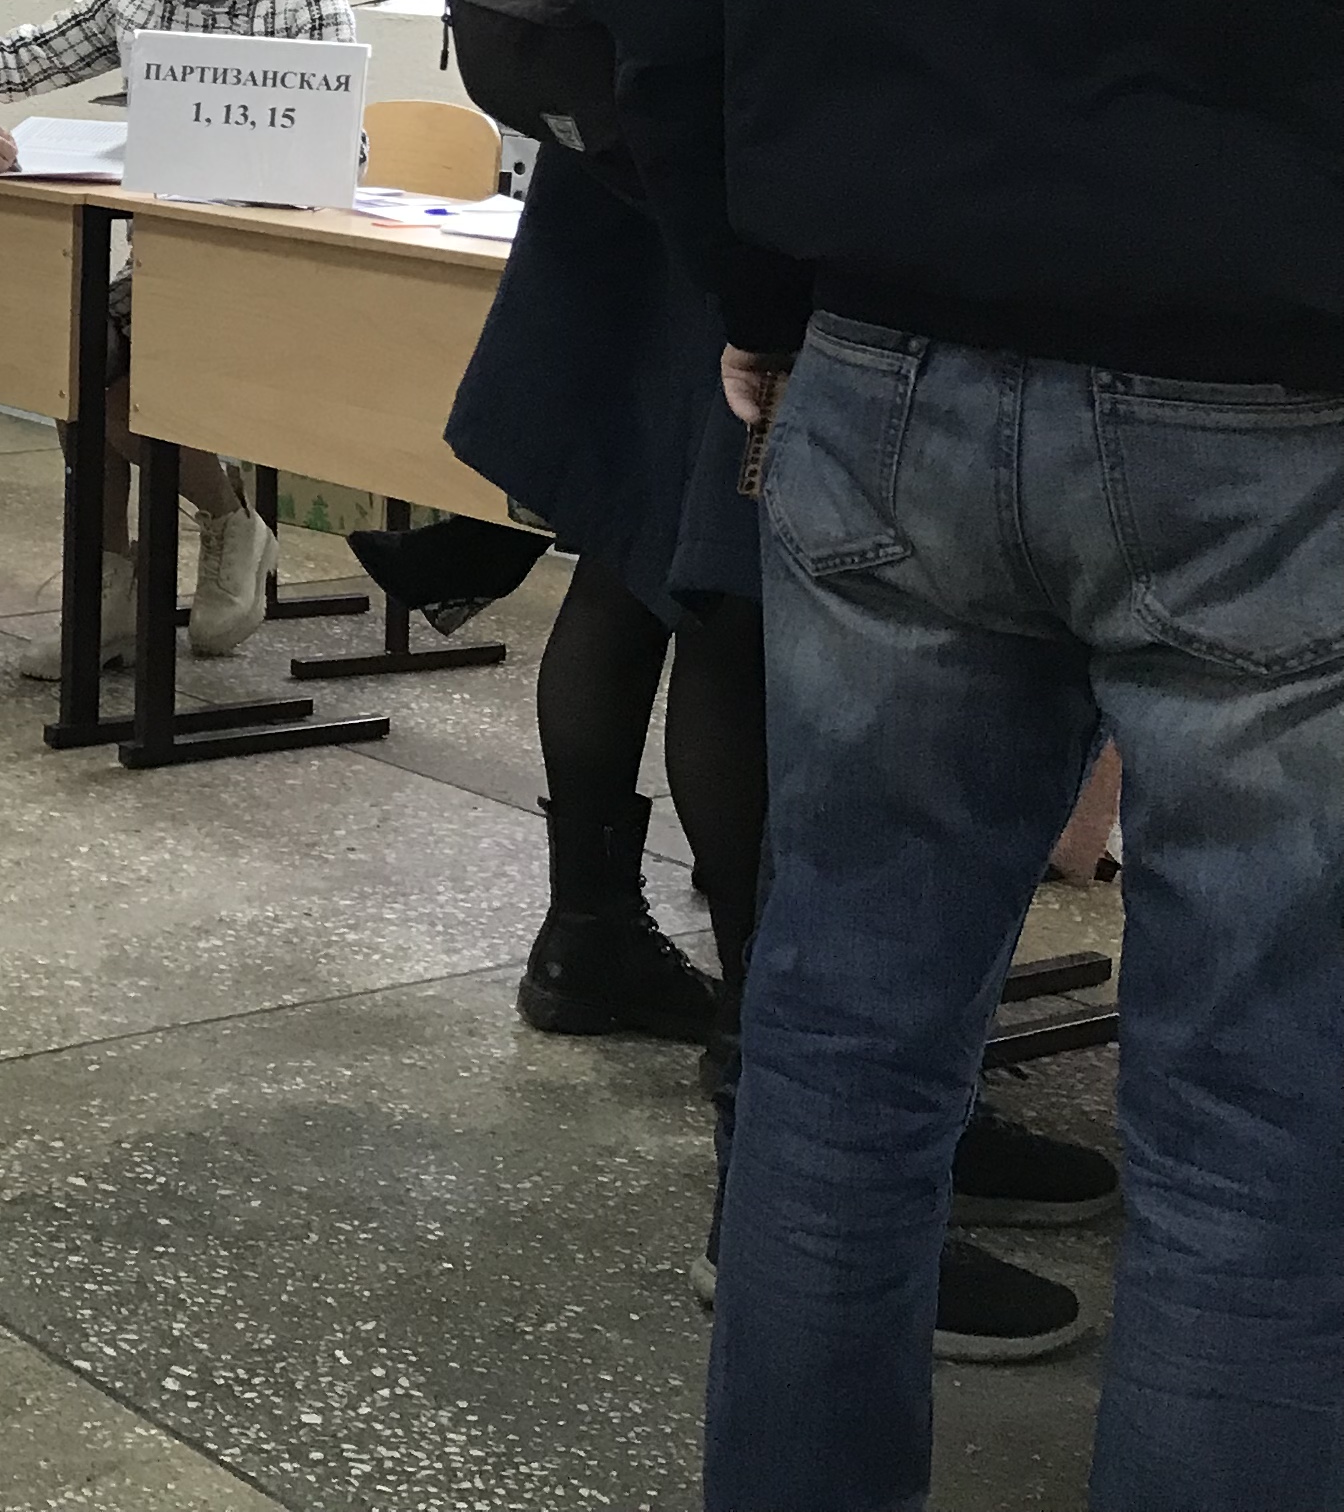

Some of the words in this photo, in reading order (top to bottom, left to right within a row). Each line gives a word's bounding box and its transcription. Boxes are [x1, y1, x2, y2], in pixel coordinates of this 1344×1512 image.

[144, 62, 352, 93] ПАРТИЗАНСКАЯ
[191, 101, 212, 127] 1,
[223, 103, 257, 130] 13,
[268, 106, 297, 129] 15
